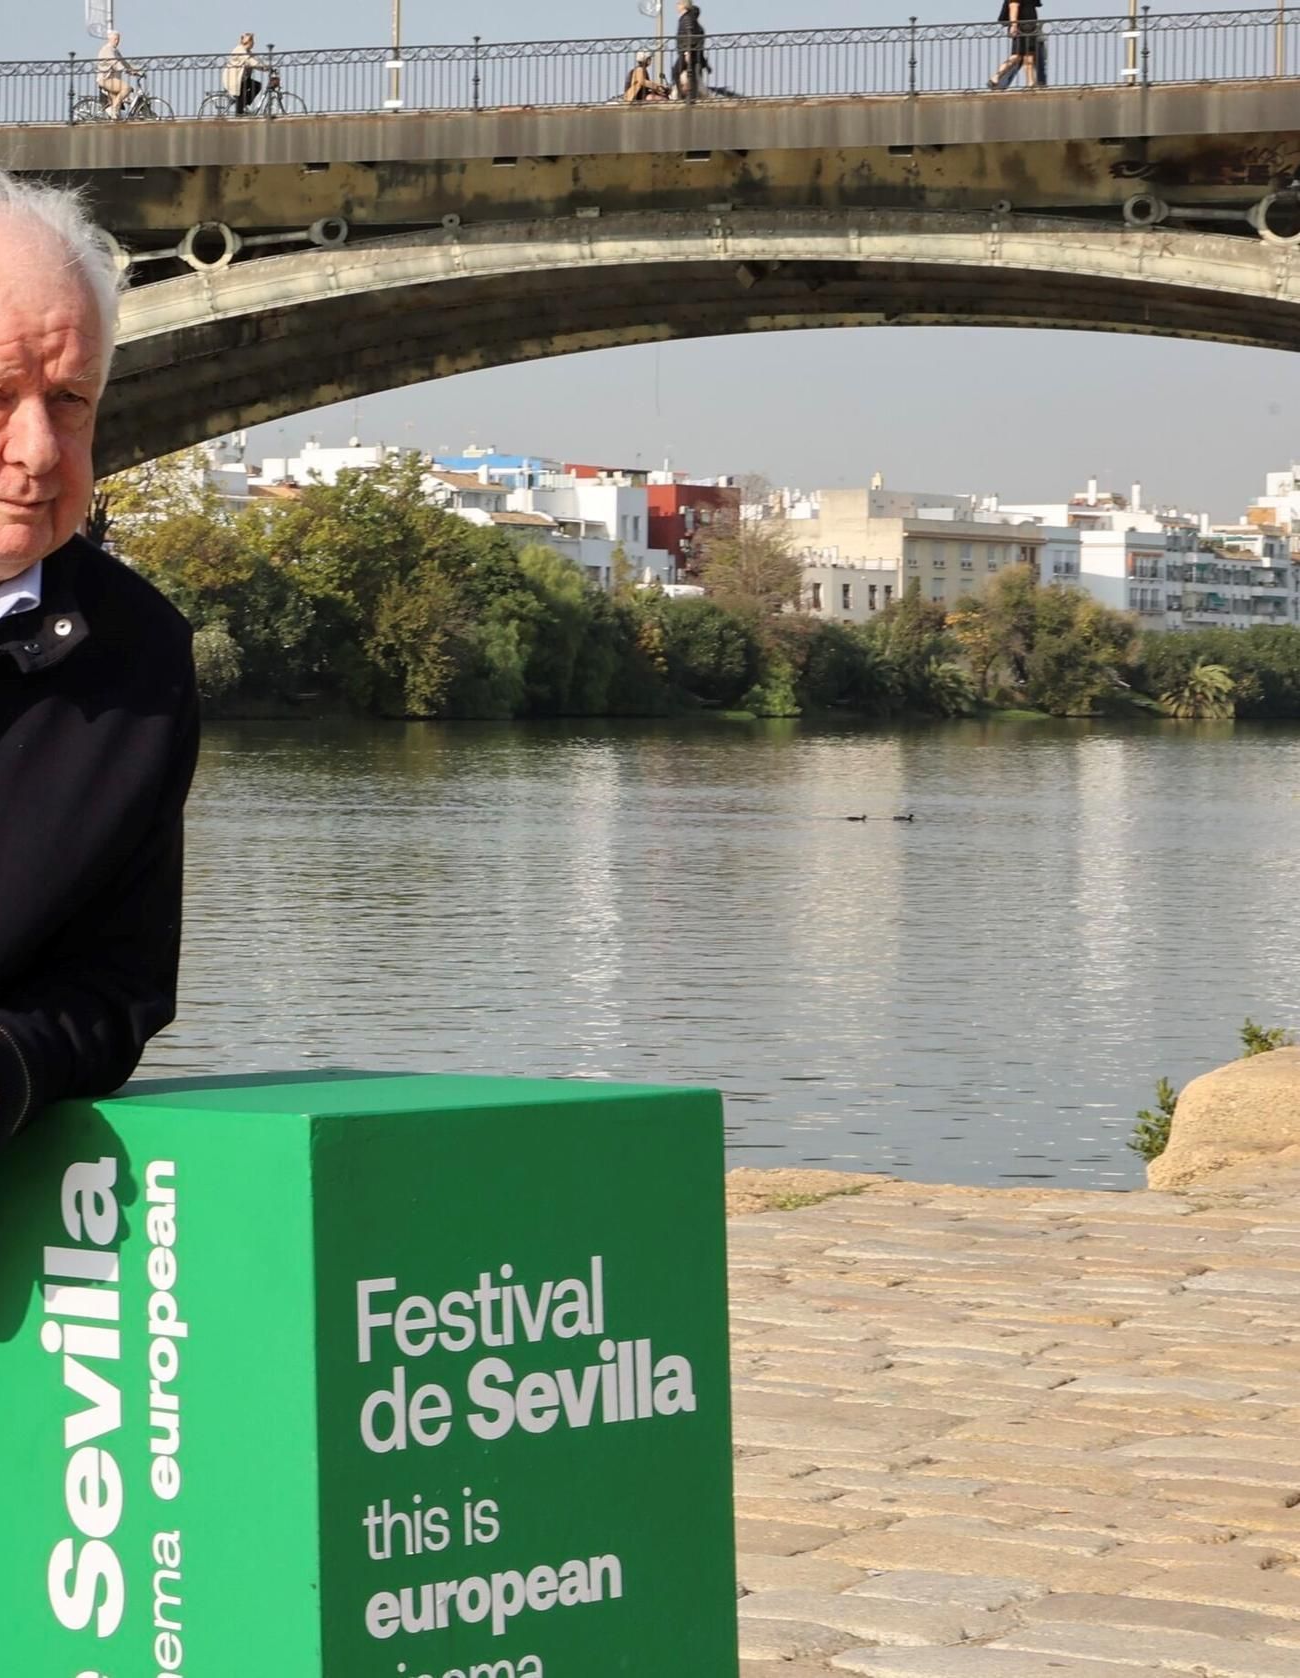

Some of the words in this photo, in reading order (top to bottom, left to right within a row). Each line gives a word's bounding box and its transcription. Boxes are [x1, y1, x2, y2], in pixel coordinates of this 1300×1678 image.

[144, 1158, 189, 1500] european
[356, 1255, 604, 1363] Festival
[41, 1157, 127, 1638] Sevilla
[360, 1365, 453, 1454] de
[467, 1338, 697, 1441] Sevilla
[363, 1495, 451, 1561] this
[463, 1487, 501, 1546] is
[365, 1553, 623, 1639] european
